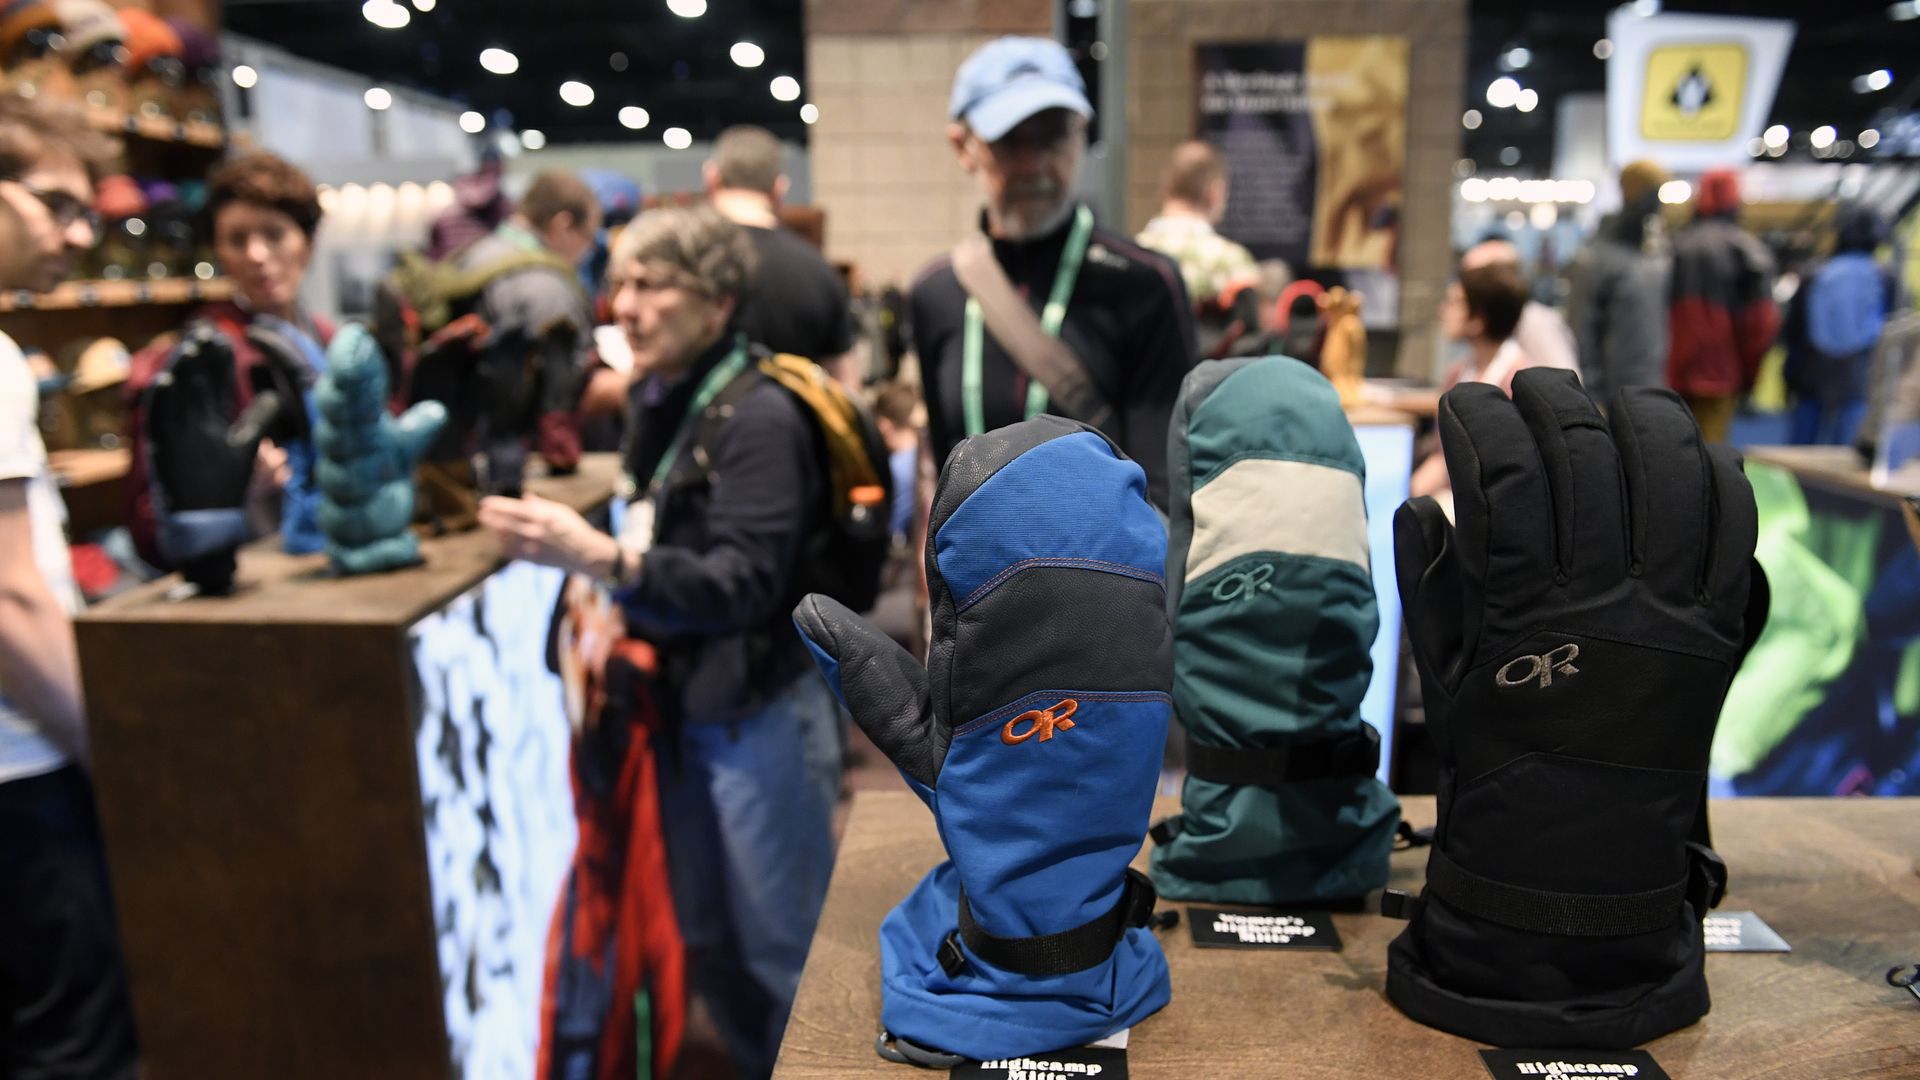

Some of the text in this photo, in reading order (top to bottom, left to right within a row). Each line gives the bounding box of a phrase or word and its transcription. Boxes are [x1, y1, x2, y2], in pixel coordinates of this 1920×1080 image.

[1212, 563, 1275, 601] OR
[1495, 643, 1580, 688] OR
[1001, 698, 1078, 745] OR
[1517, 1061, 1638, 1076] Highcamp
